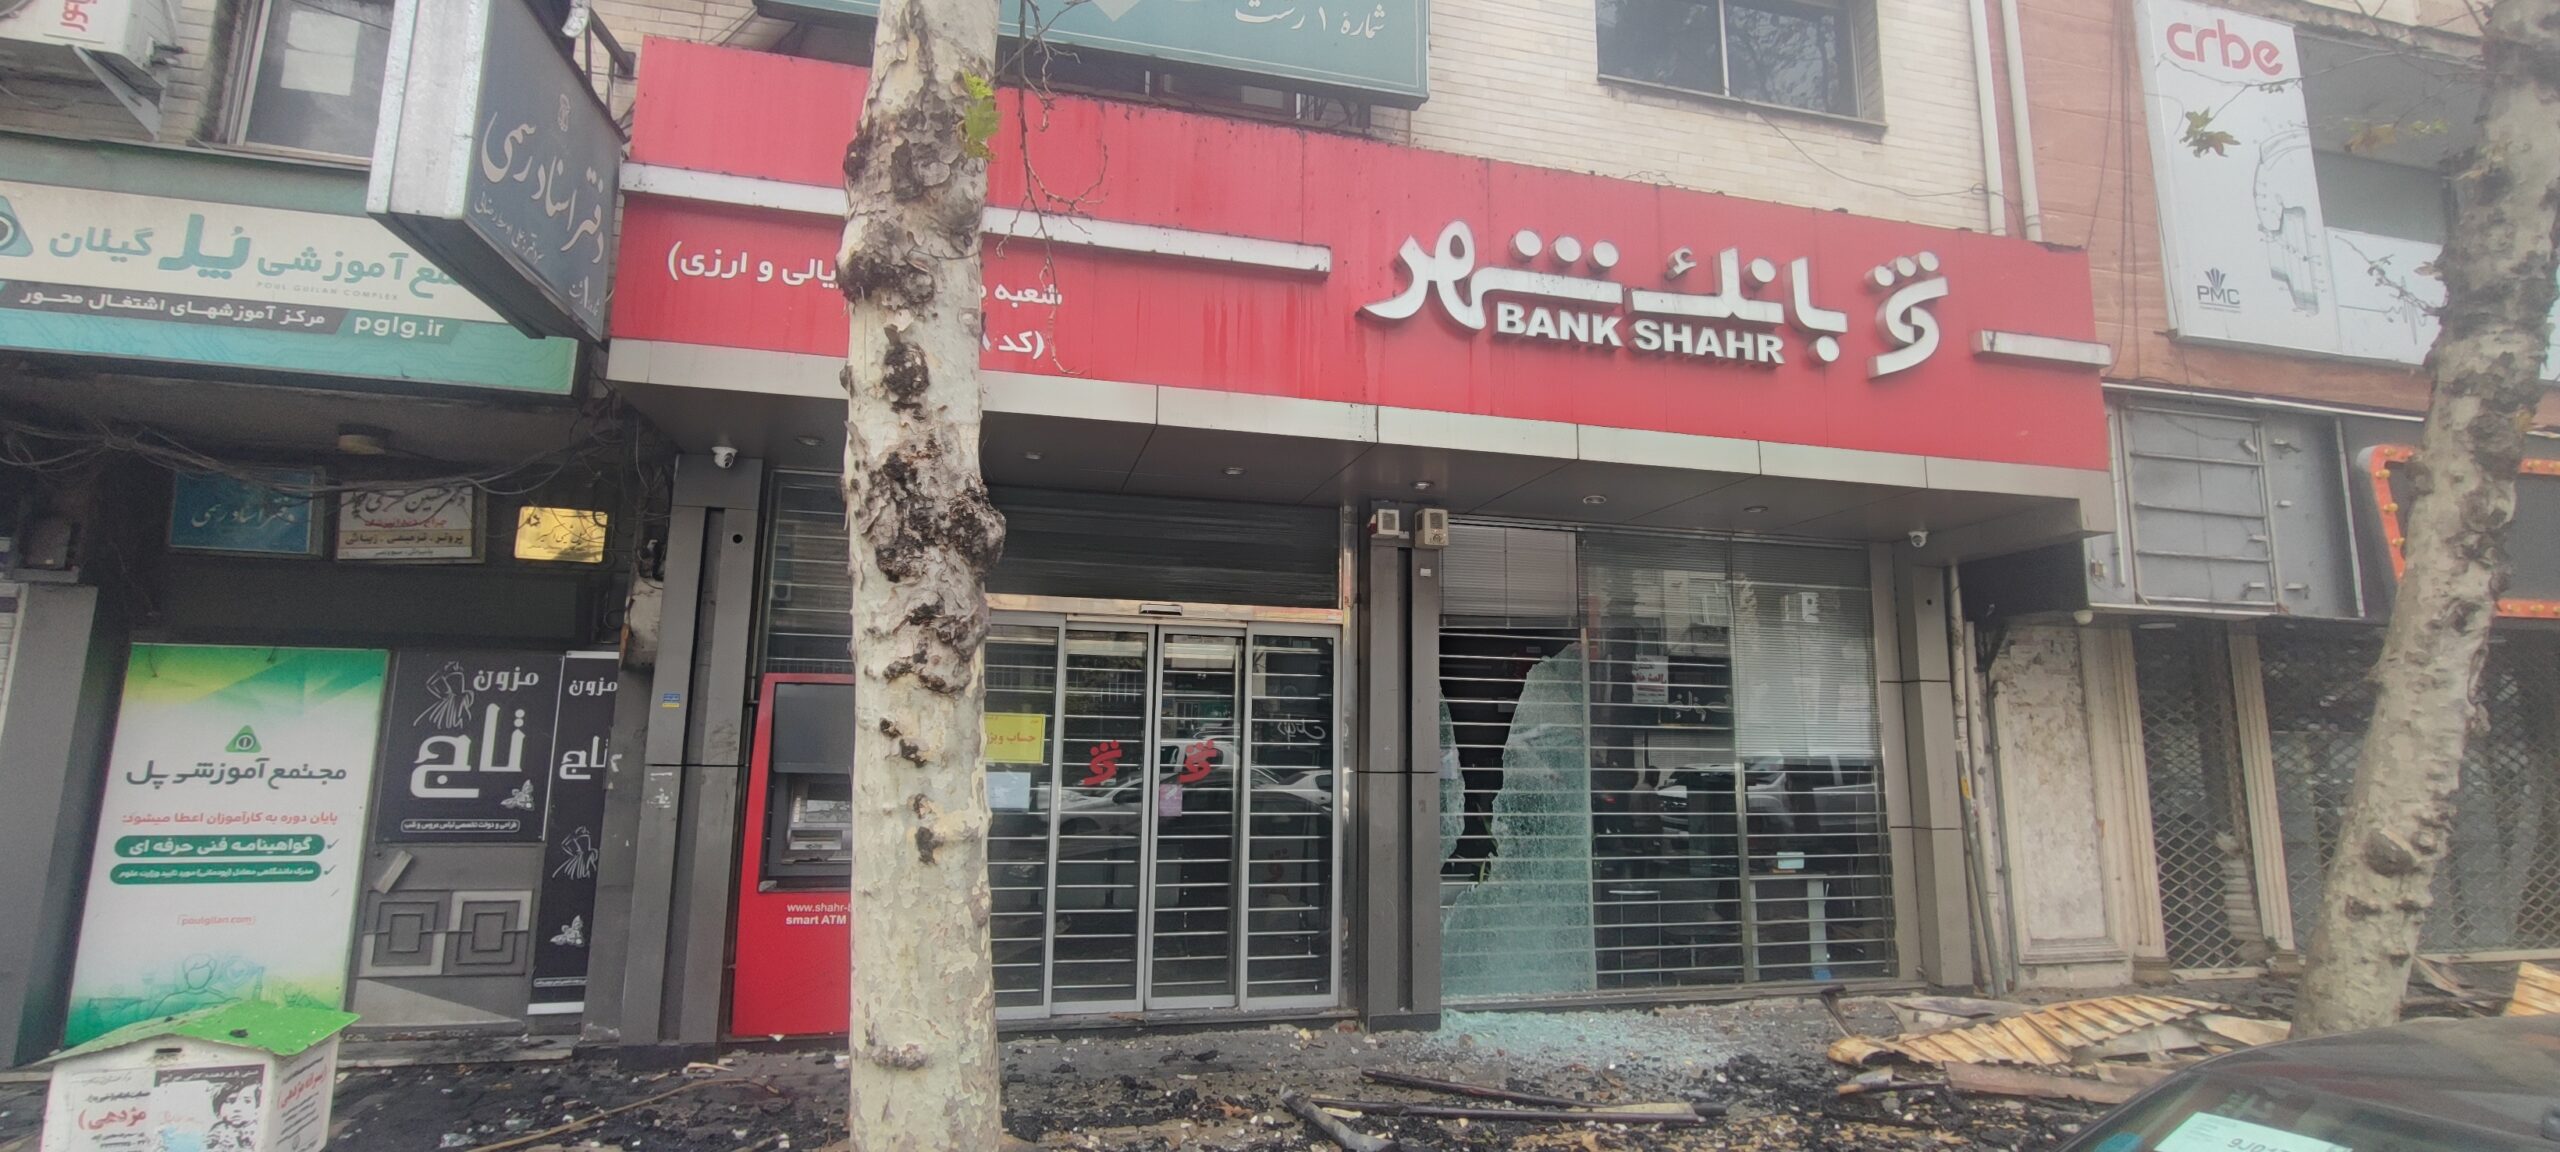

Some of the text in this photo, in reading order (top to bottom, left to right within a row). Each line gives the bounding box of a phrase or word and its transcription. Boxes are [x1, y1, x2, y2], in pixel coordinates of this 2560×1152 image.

[1318, 6, 1327, 31] ۱
[2166, 19, 2284, 76] crbe
[481, 111, 604, 264] دفتر اسناد رسمی
[48, 226, 155, 263] گیلان
[257, 246, 409, 284] آموزشی
[668, 240, 748, 281] ارزی)
[757, 259, 774, 283] و
[782, 258, 839, 289] یالی
[1360, 218, 1624, 333] شهر
[994, 283, 1063, 309] شعبه
[2197, 285, 2241, 305] PMC
[20, 291, 326, 327] مرکز آموزشهای اشتغال محور
[354, 315, 444, 338] pglg.ir
[1494, 301, 1786, 370] BANK SHAHR
[998, 331, 1045, 360] (کد
[568, 677, 618, 697] مزون
[410, 666, 539, 798] مزون تاج
[126, 758, 347, 790] مجتمع آموزشی پل
[174, 811, 204, 824] اعطا
[265, 813, 278, 825] به
[280, 814, 307, 825] دوره
[310, 811, 338, 826] پایان
[128, 836, 313, 856] گواهینامه فنی حرفه ای
[786, 915, 847, 925] smart ATM
